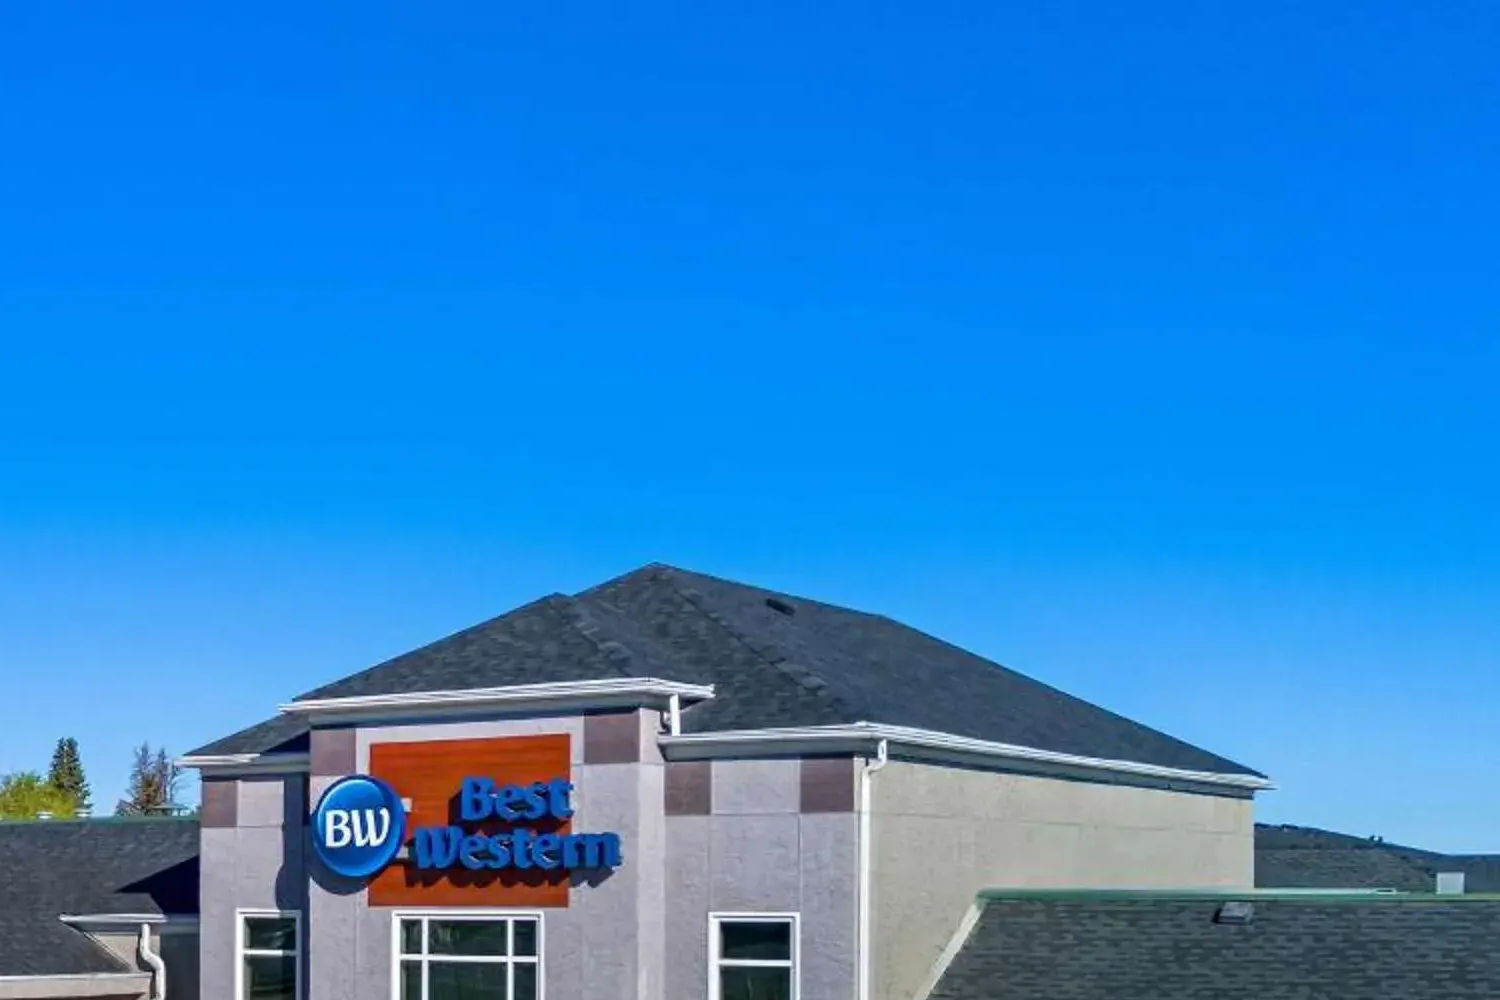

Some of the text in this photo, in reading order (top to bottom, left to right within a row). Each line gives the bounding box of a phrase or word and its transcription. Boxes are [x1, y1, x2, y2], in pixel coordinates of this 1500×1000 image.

[460, 777, 574, 821] Best
[325, 808, 390, 848] BW
[413, 826, 622, 869] Western
